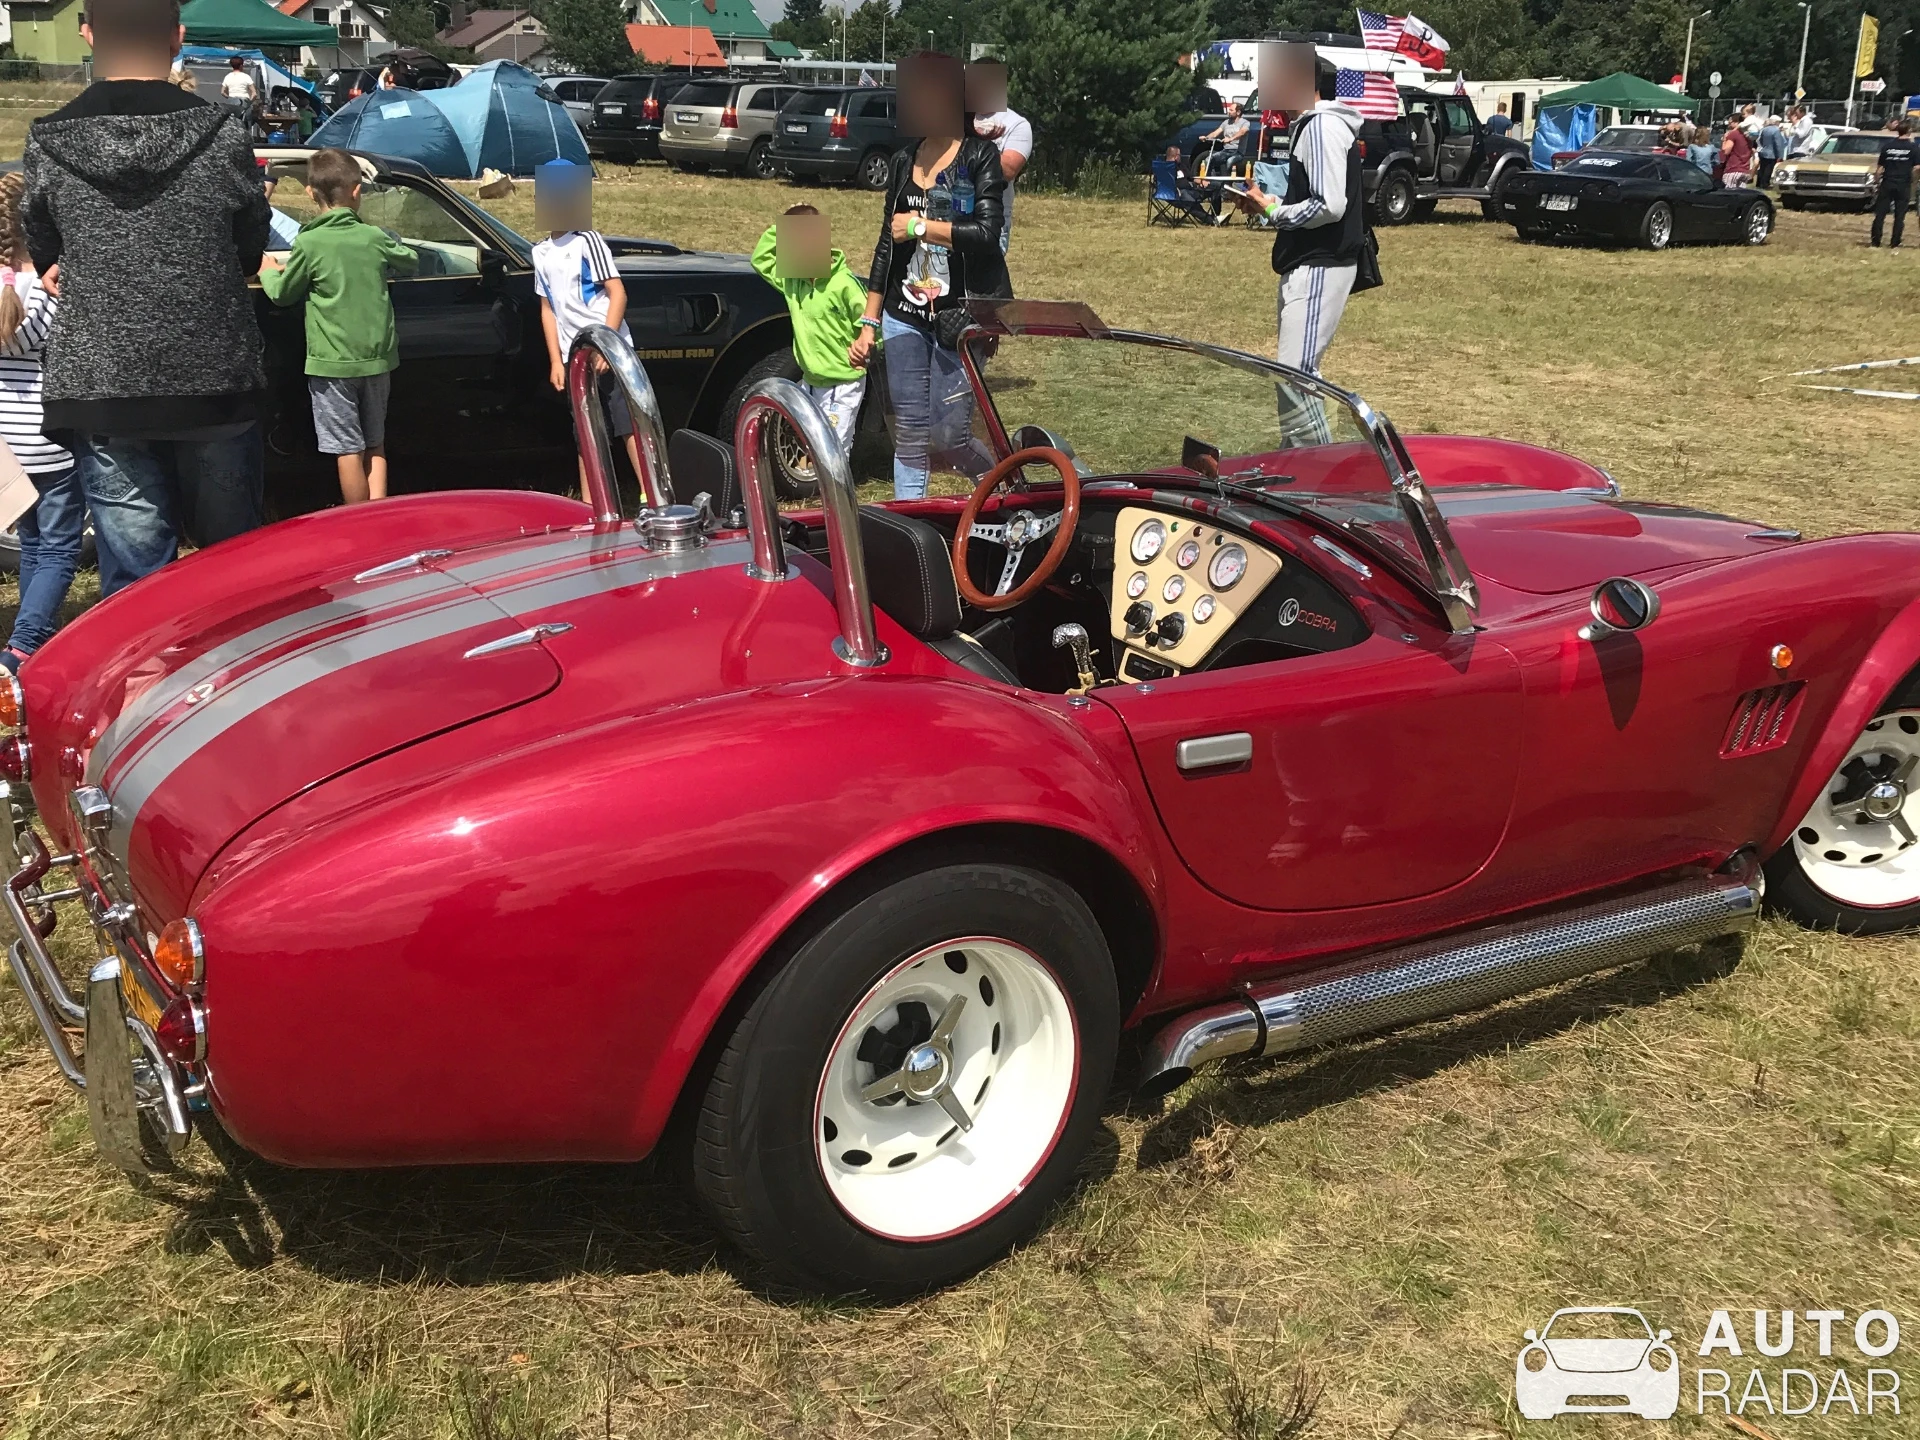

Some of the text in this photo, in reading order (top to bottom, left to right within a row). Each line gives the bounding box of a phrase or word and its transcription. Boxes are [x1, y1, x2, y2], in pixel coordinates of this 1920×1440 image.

[635, 348, 714, 359] RANS AM
[1297, 609, 1337, 632] COBRA
